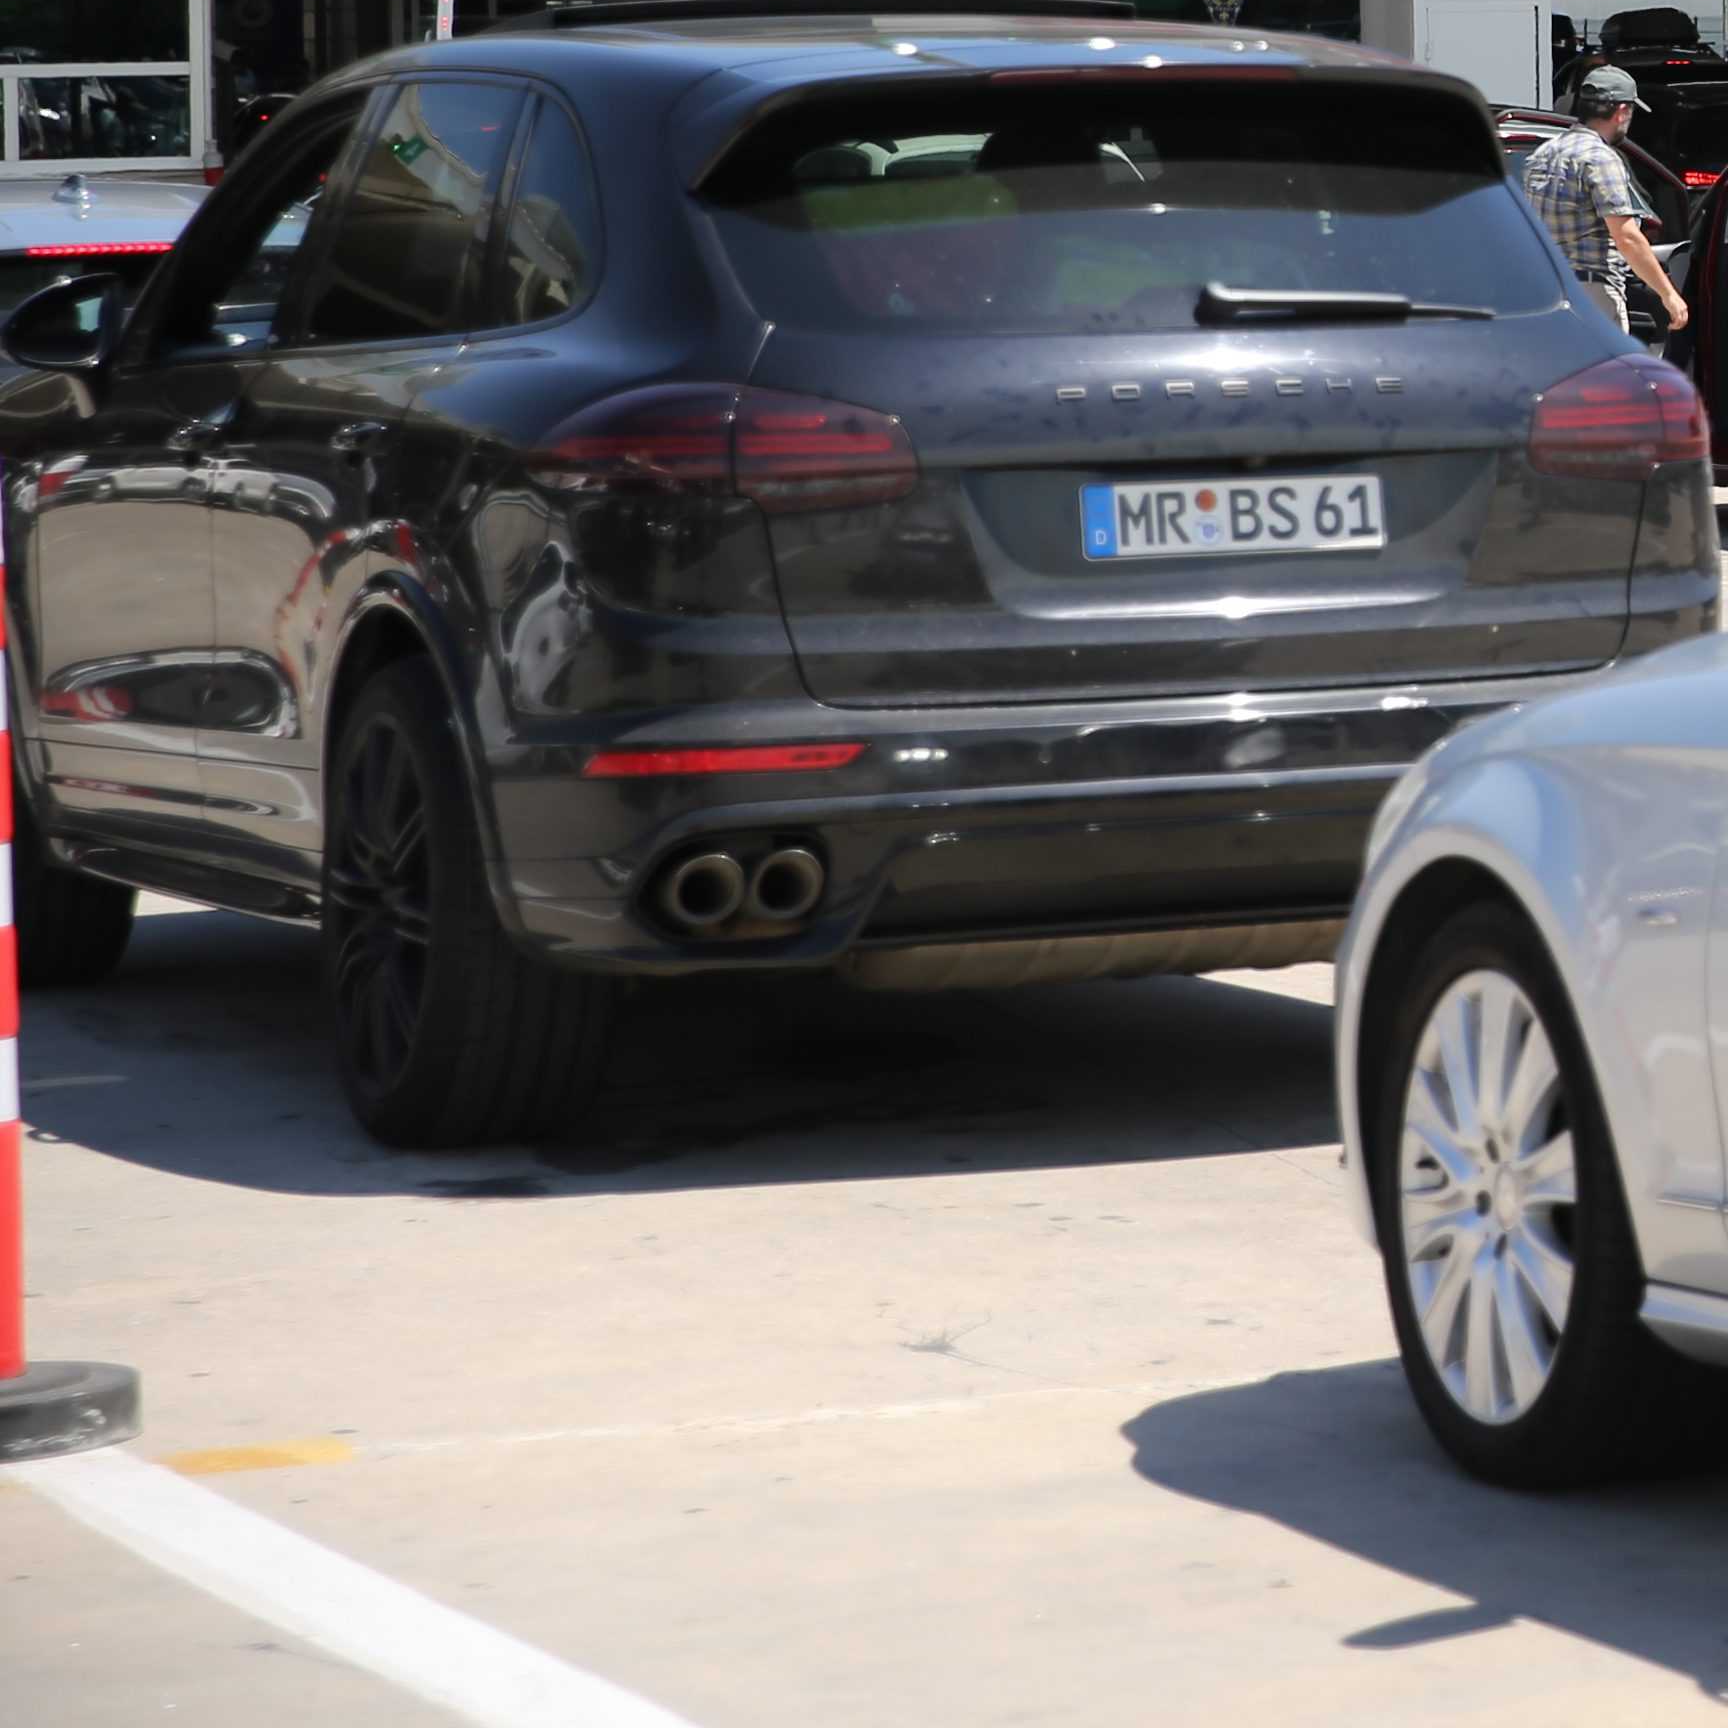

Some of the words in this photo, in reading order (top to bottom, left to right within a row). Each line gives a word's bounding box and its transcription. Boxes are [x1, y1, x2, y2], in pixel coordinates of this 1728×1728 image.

[1056, 376, 1405, 401] PORSCHE
[1118, 491, 1191, 547] MR
[1229, 485, 1300, 542] BS
[1314, 483, 1379, 539] 61
